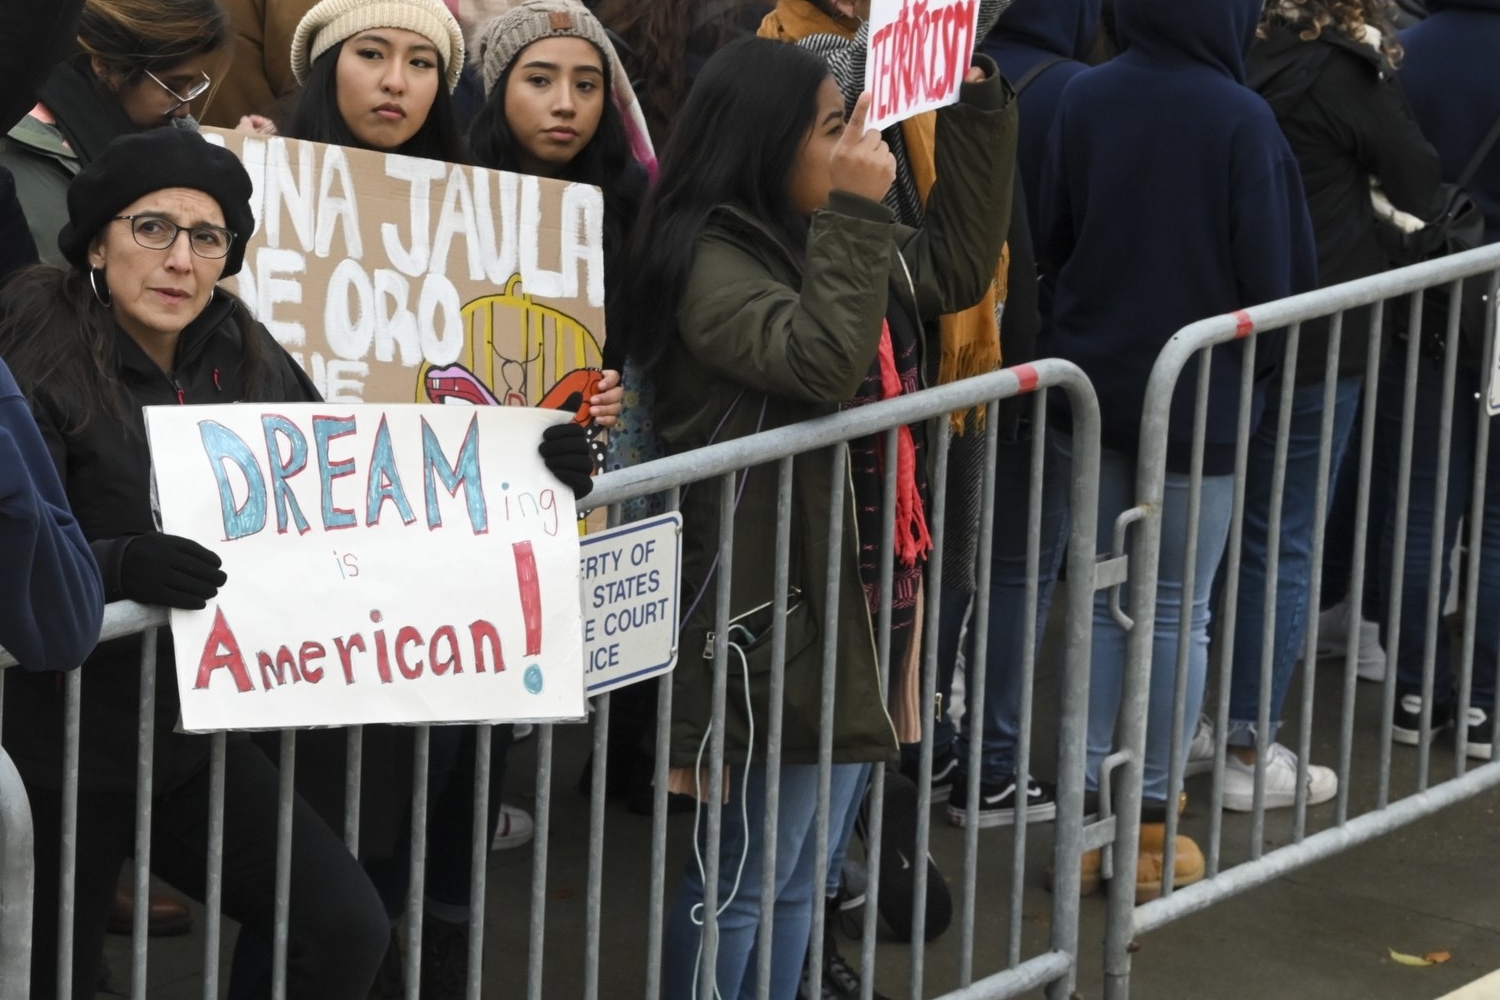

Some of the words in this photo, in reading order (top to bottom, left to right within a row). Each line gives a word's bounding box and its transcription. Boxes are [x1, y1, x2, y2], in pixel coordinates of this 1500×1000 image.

[380, 152, 604, 308] JAULA
[323, 257, 465, 366] ORO
[333, 550, 359, 580] is
[631, 539, 656, 567] OF
[592, 569, 660, 609] STATES
[604, 597, 669, 636] COURT
[585, 643, 620, 674] ICE
